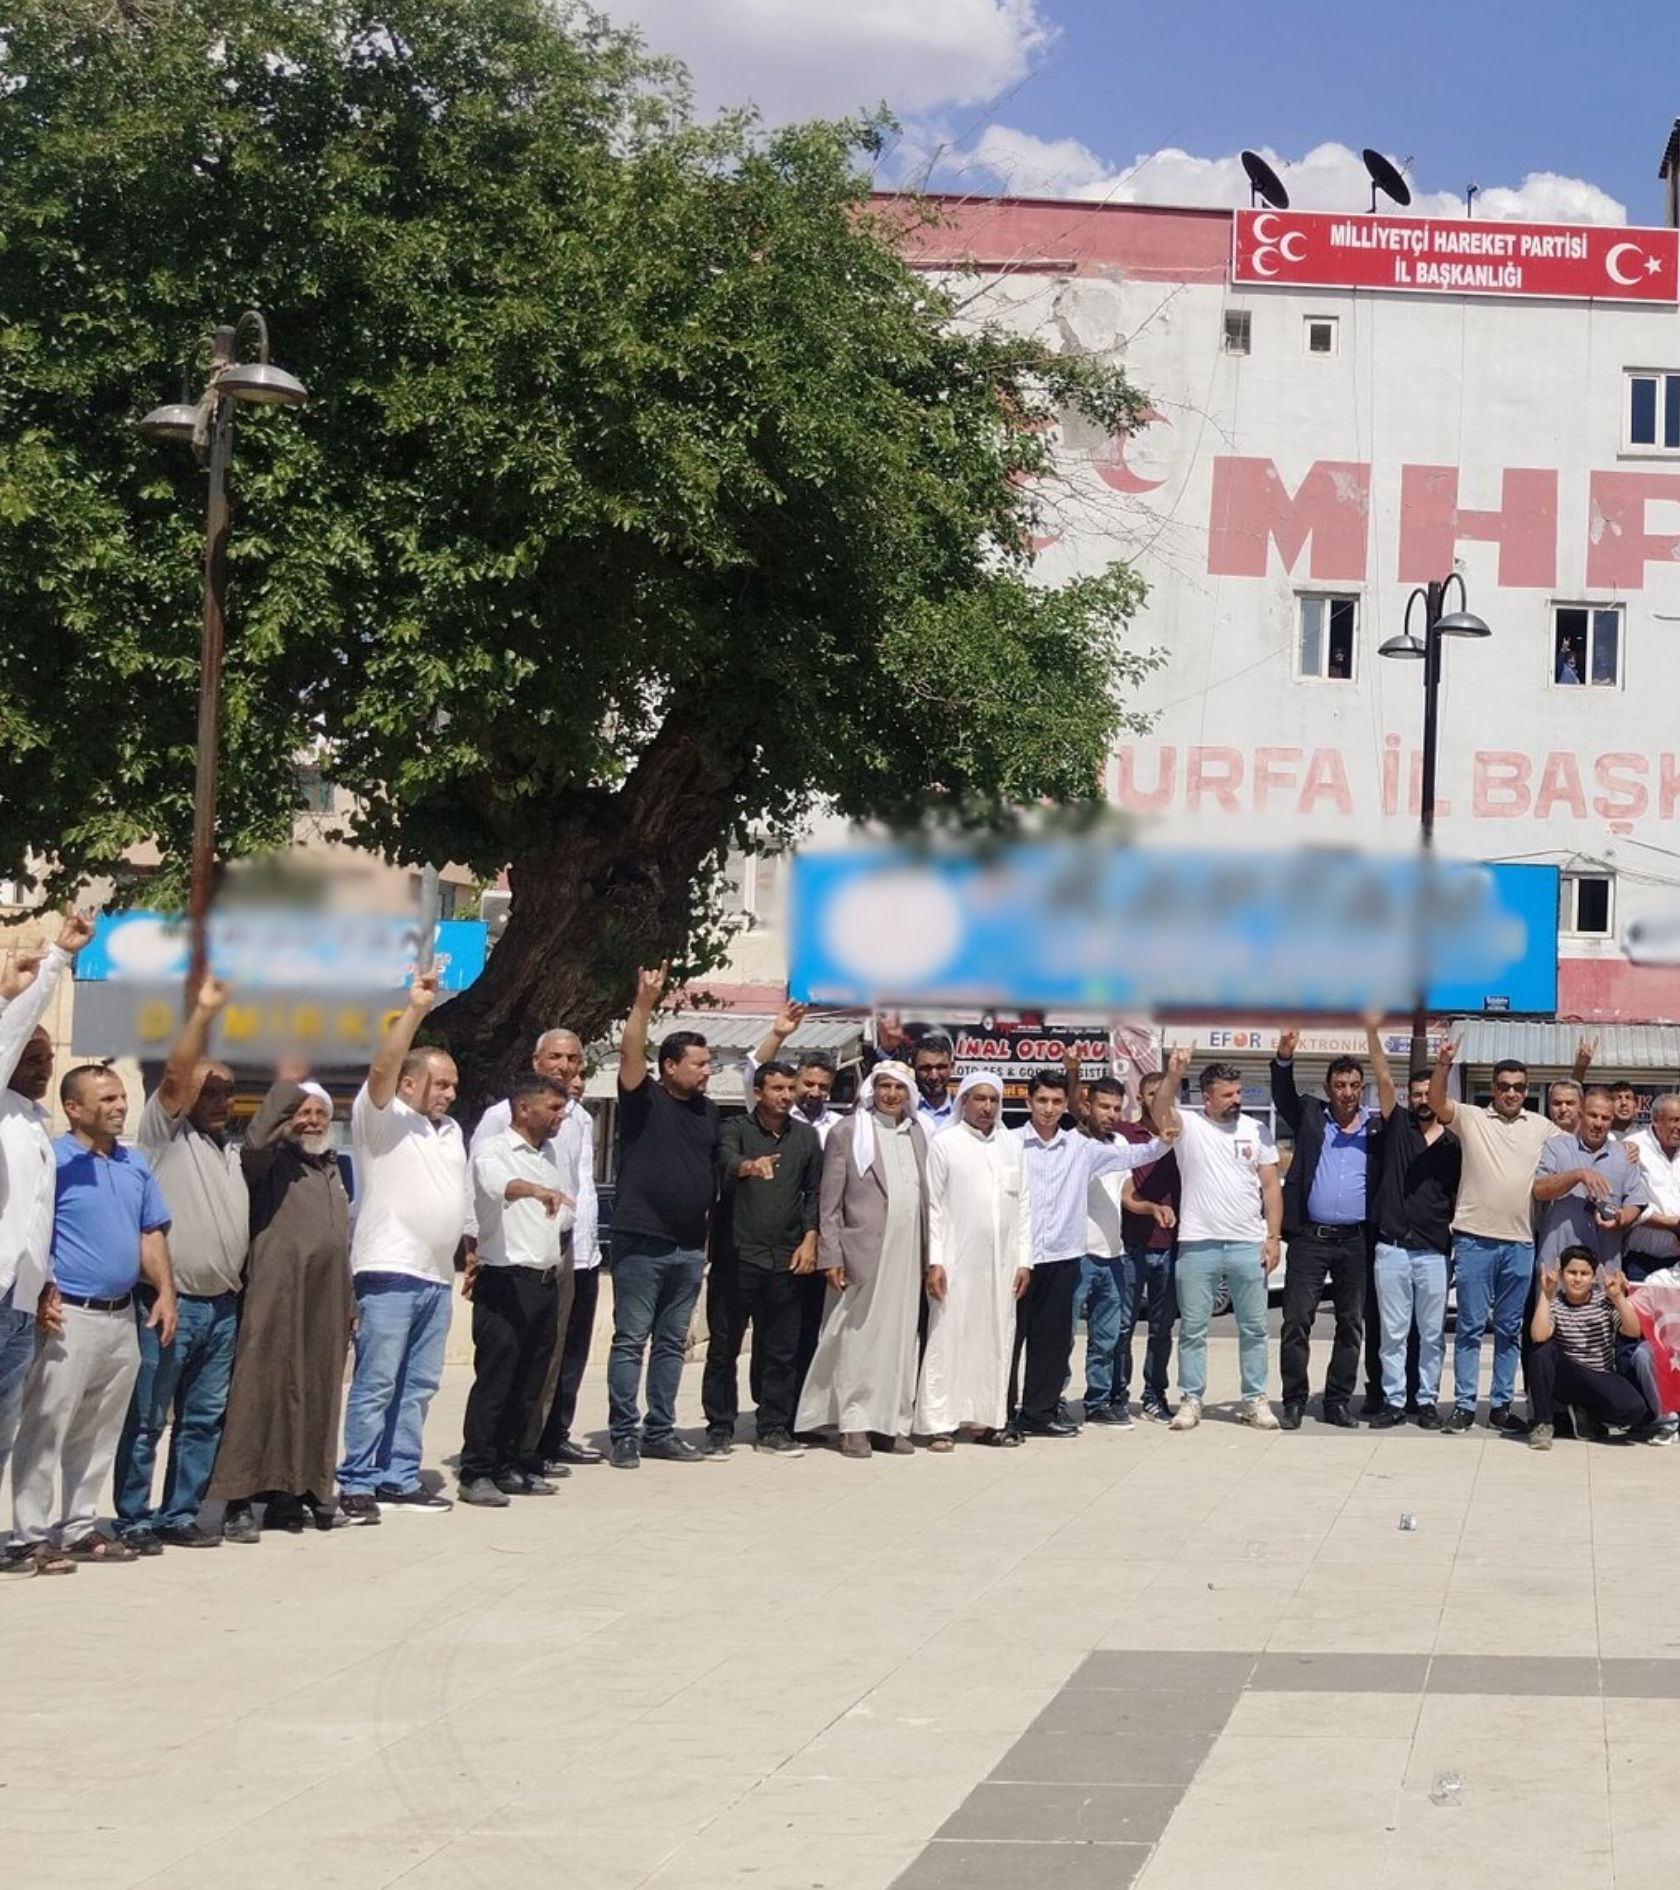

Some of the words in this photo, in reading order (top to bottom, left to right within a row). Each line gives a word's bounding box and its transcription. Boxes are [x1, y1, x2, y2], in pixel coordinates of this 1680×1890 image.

[1330, 221, 1429, 257] MİLLİYETÇİ
[1434, 231, 1516, 256] HAREKET
[1520, 231, 1588, 260] PARTİSİ
[1395, 256, 1411, 282] İL
[1416, 261, 1522, 290] BAŞKANLIĞI
[1098, 745, 1354, 815] URFA
[1382, 732, 1451, 816] İL
[1017, 1038, 1065, 1060] OTO
[1210, 1031, 1262, 1049] EFOR
[1271, 1034, 1369, 1051] EKTRONİK
